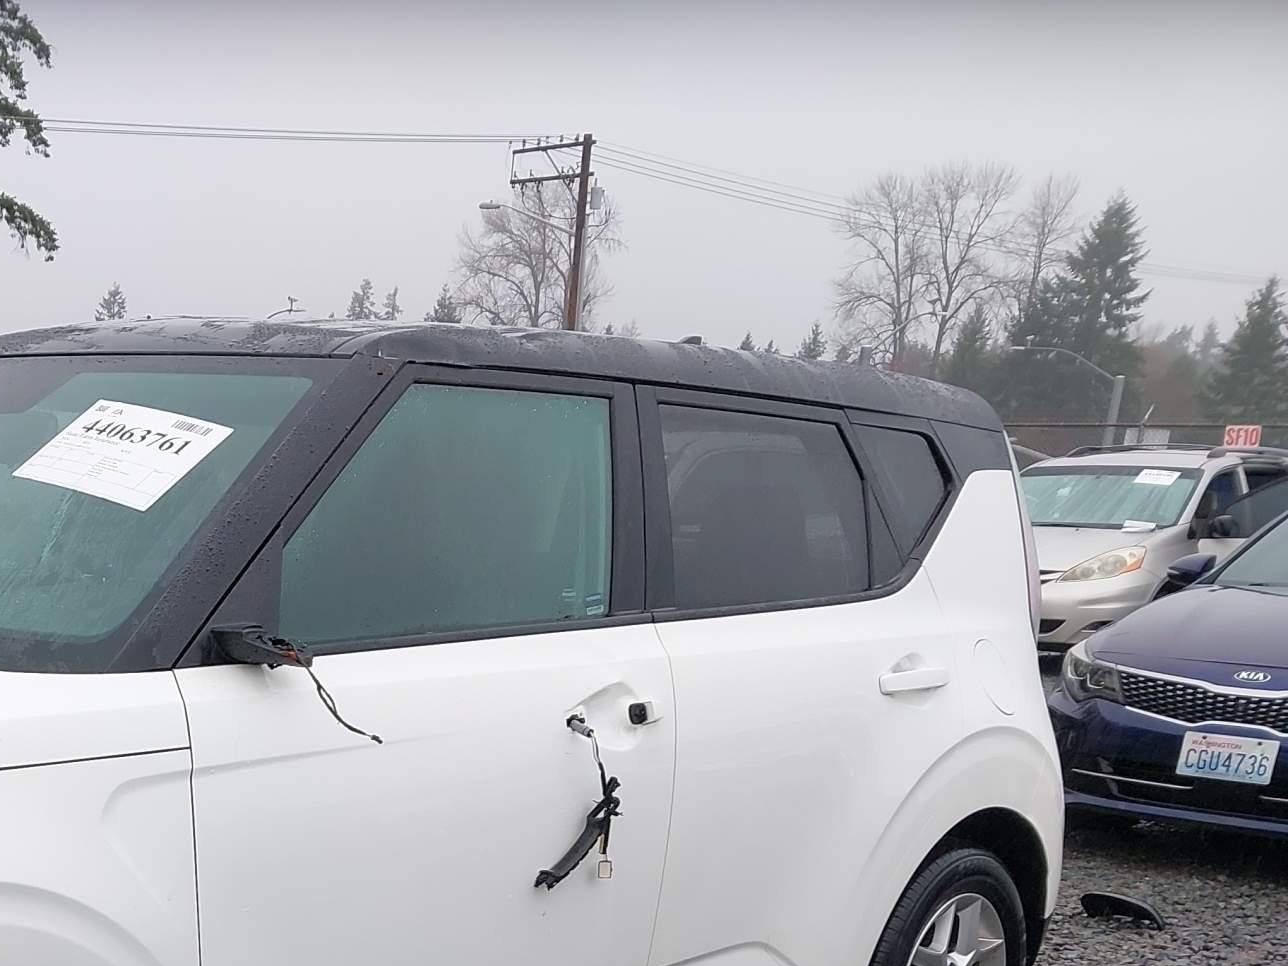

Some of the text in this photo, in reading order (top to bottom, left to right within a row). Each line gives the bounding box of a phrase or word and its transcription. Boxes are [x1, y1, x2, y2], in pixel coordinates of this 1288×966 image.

[82, 419, 192, 455] 44063761
[1226, 427, 1259, 446] SF10
[1239, 671, 1265, 681] KIA
[1192, 739, 1242, 750] WASHINGTON
[1184, 747, 1270, 777] CGU4736
